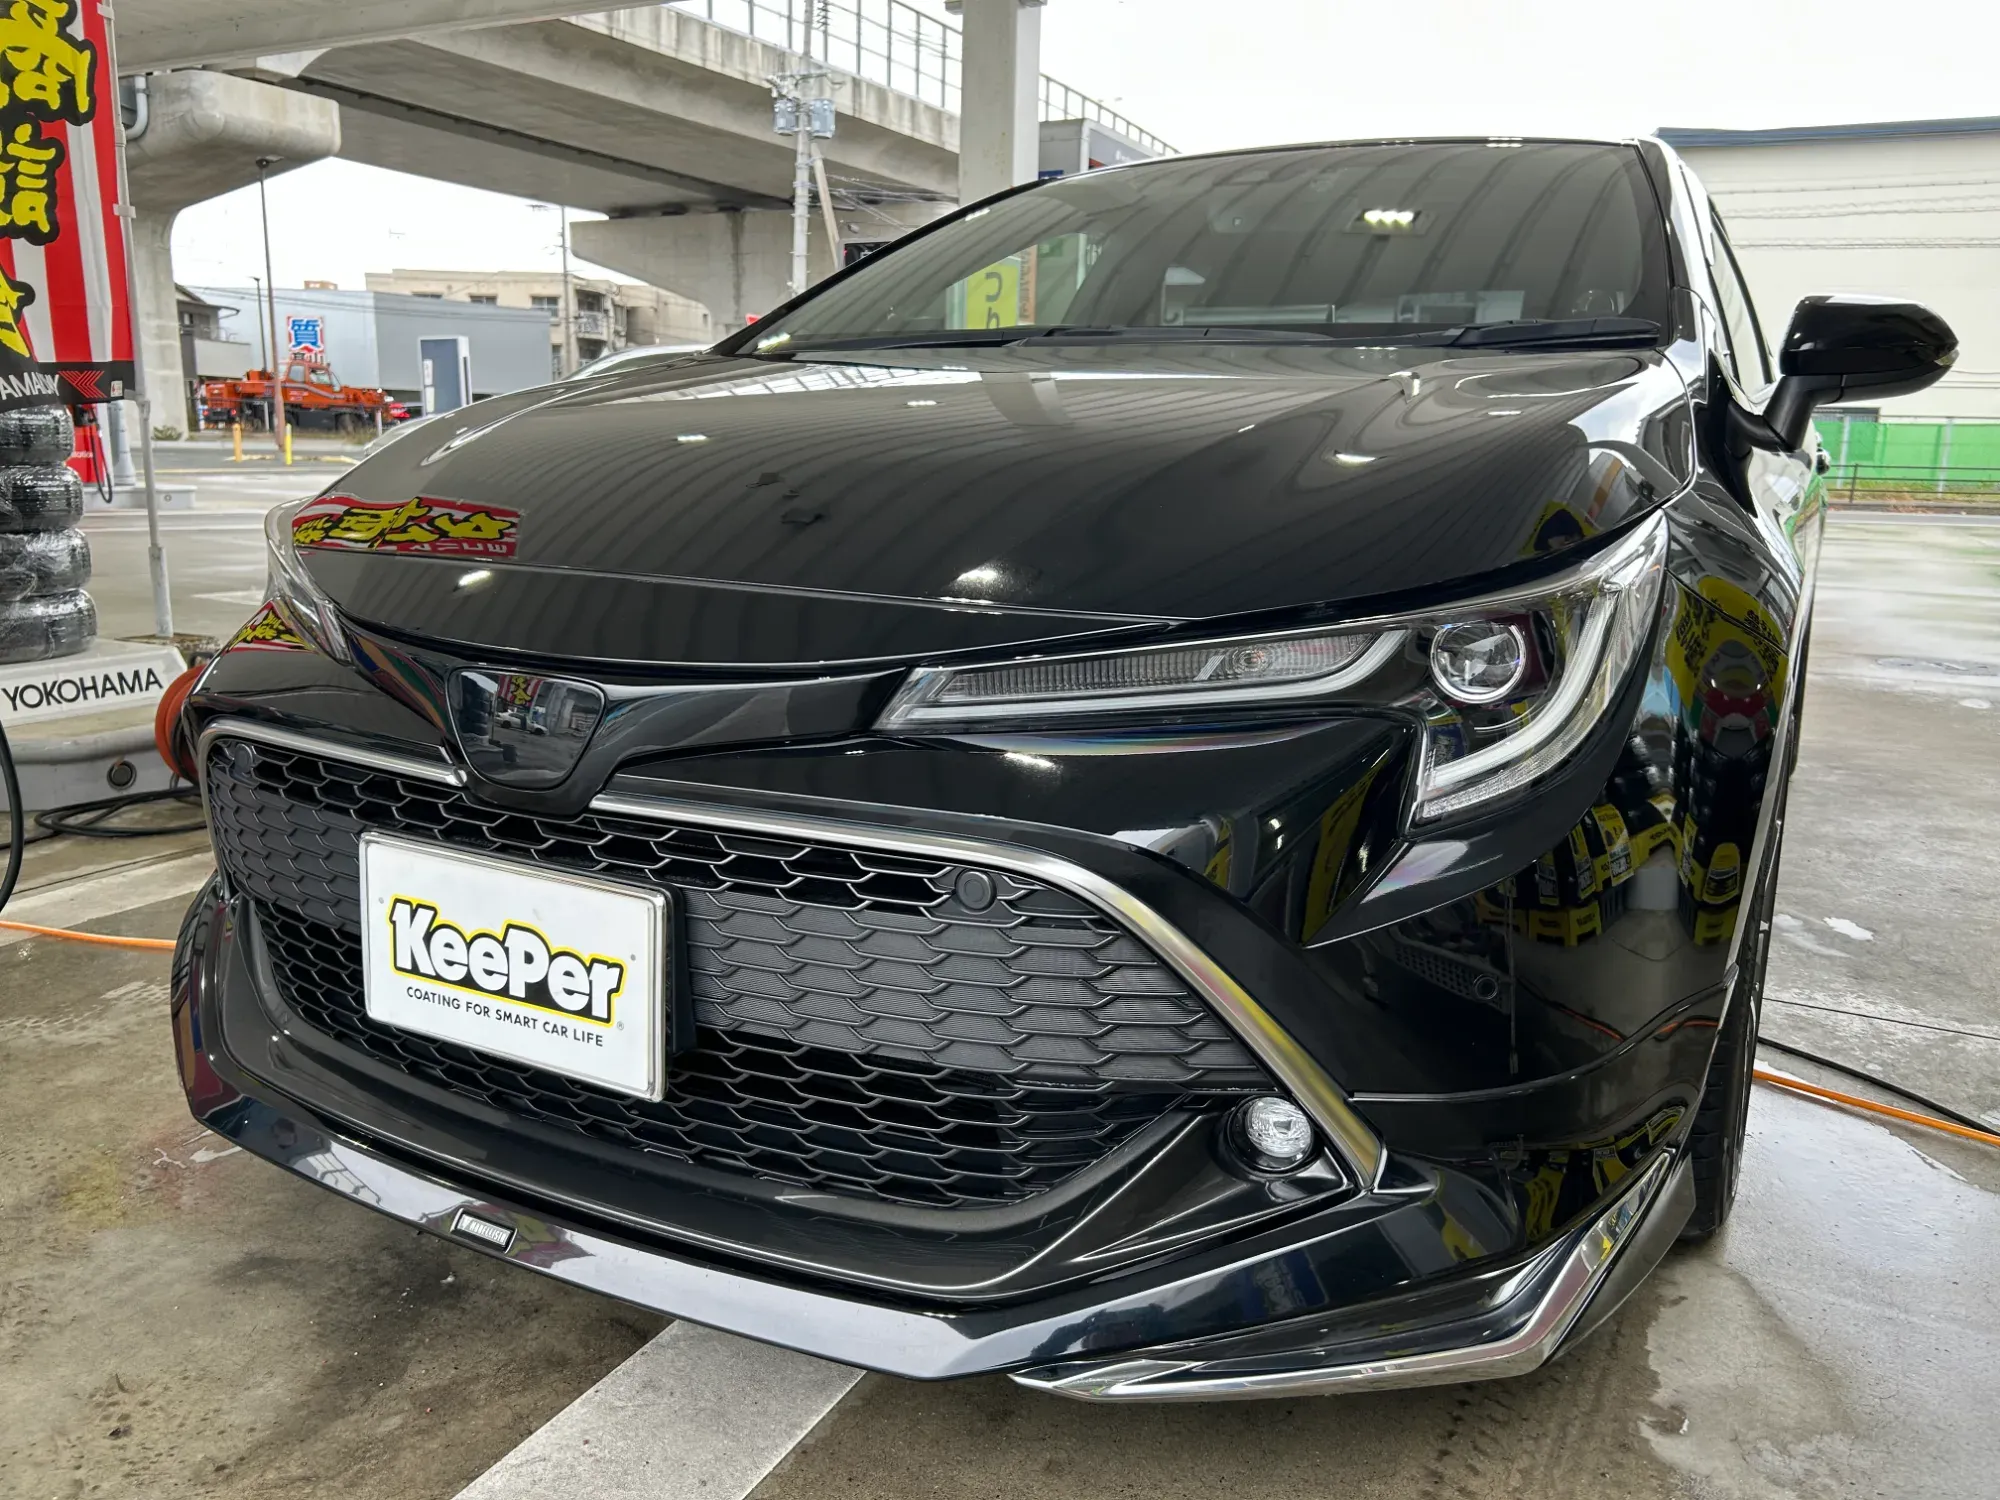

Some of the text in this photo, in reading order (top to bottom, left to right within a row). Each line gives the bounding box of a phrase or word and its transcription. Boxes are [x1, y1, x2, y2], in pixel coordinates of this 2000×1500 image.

[291, 318, 321, 348] 質
[1, 668, 163, 711] YOKOHAMA
[387, 895, 627, 1027] KeePer
[406, 986, 604, 1047] COATING FOR SMART CAR LIFE
